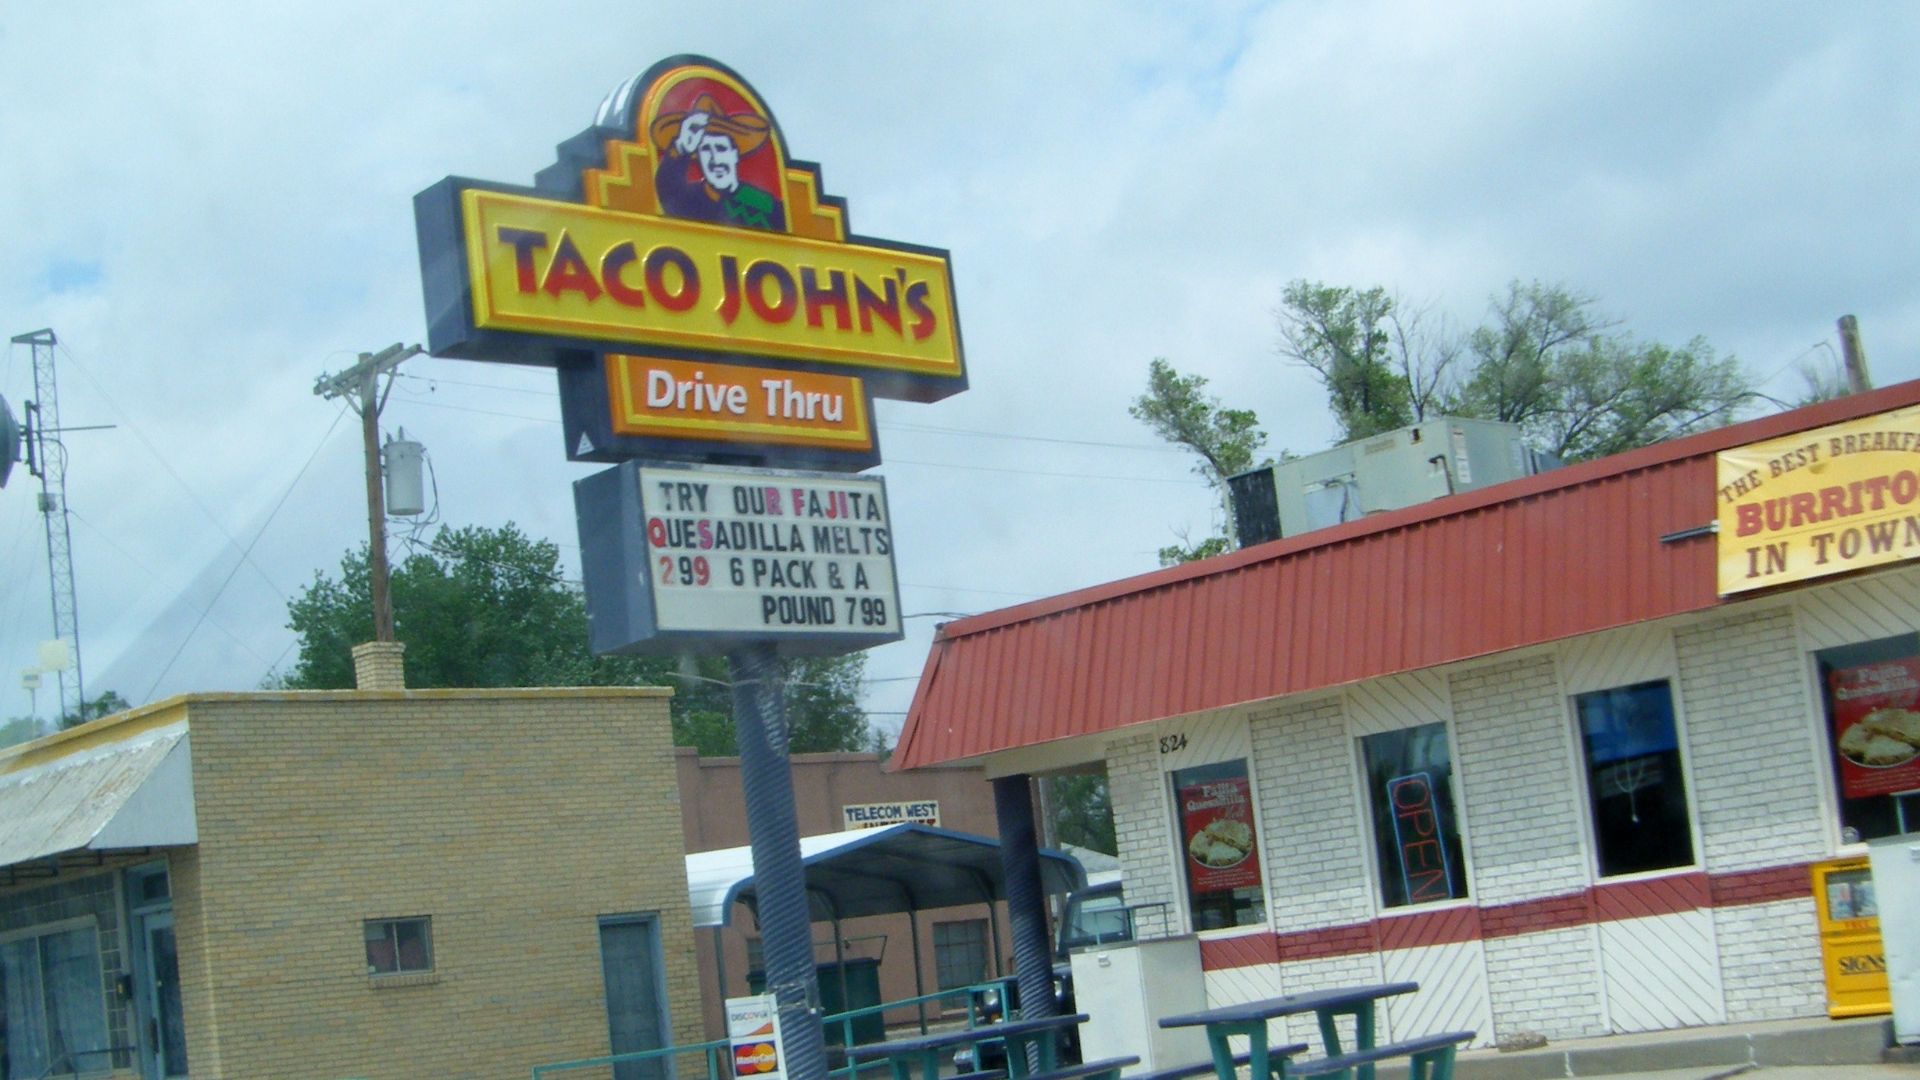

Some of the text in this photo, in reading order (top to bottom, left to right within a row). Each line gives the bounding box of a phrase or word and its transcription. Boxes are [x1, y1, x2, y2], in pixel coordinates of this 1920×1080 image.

[498, 225, 937, 341] TACO JOHN'S
[645, 368, 844, 423] Drive Thru
[1720, 469, 1763, 504] THE
[1768, 442, 1820, 479] BEST
[659, 482, 881, 521] TRY OUR FAJITA
[1736, 469, 1920, 538] BURRITO
[648, 517, 890, 556] QUESADILLA MELTS
[1746, 513, 1920, 579] IN TOWN
[659, 555, 869, 590] 299 6 PACK & A
[762, 595, 888, 626] POUND 799
[1160, 733, 1188, 754] 824
[845, 803, 937, 821] TELECOM WEST
[1393, 778, 1447, 900] OPEN
